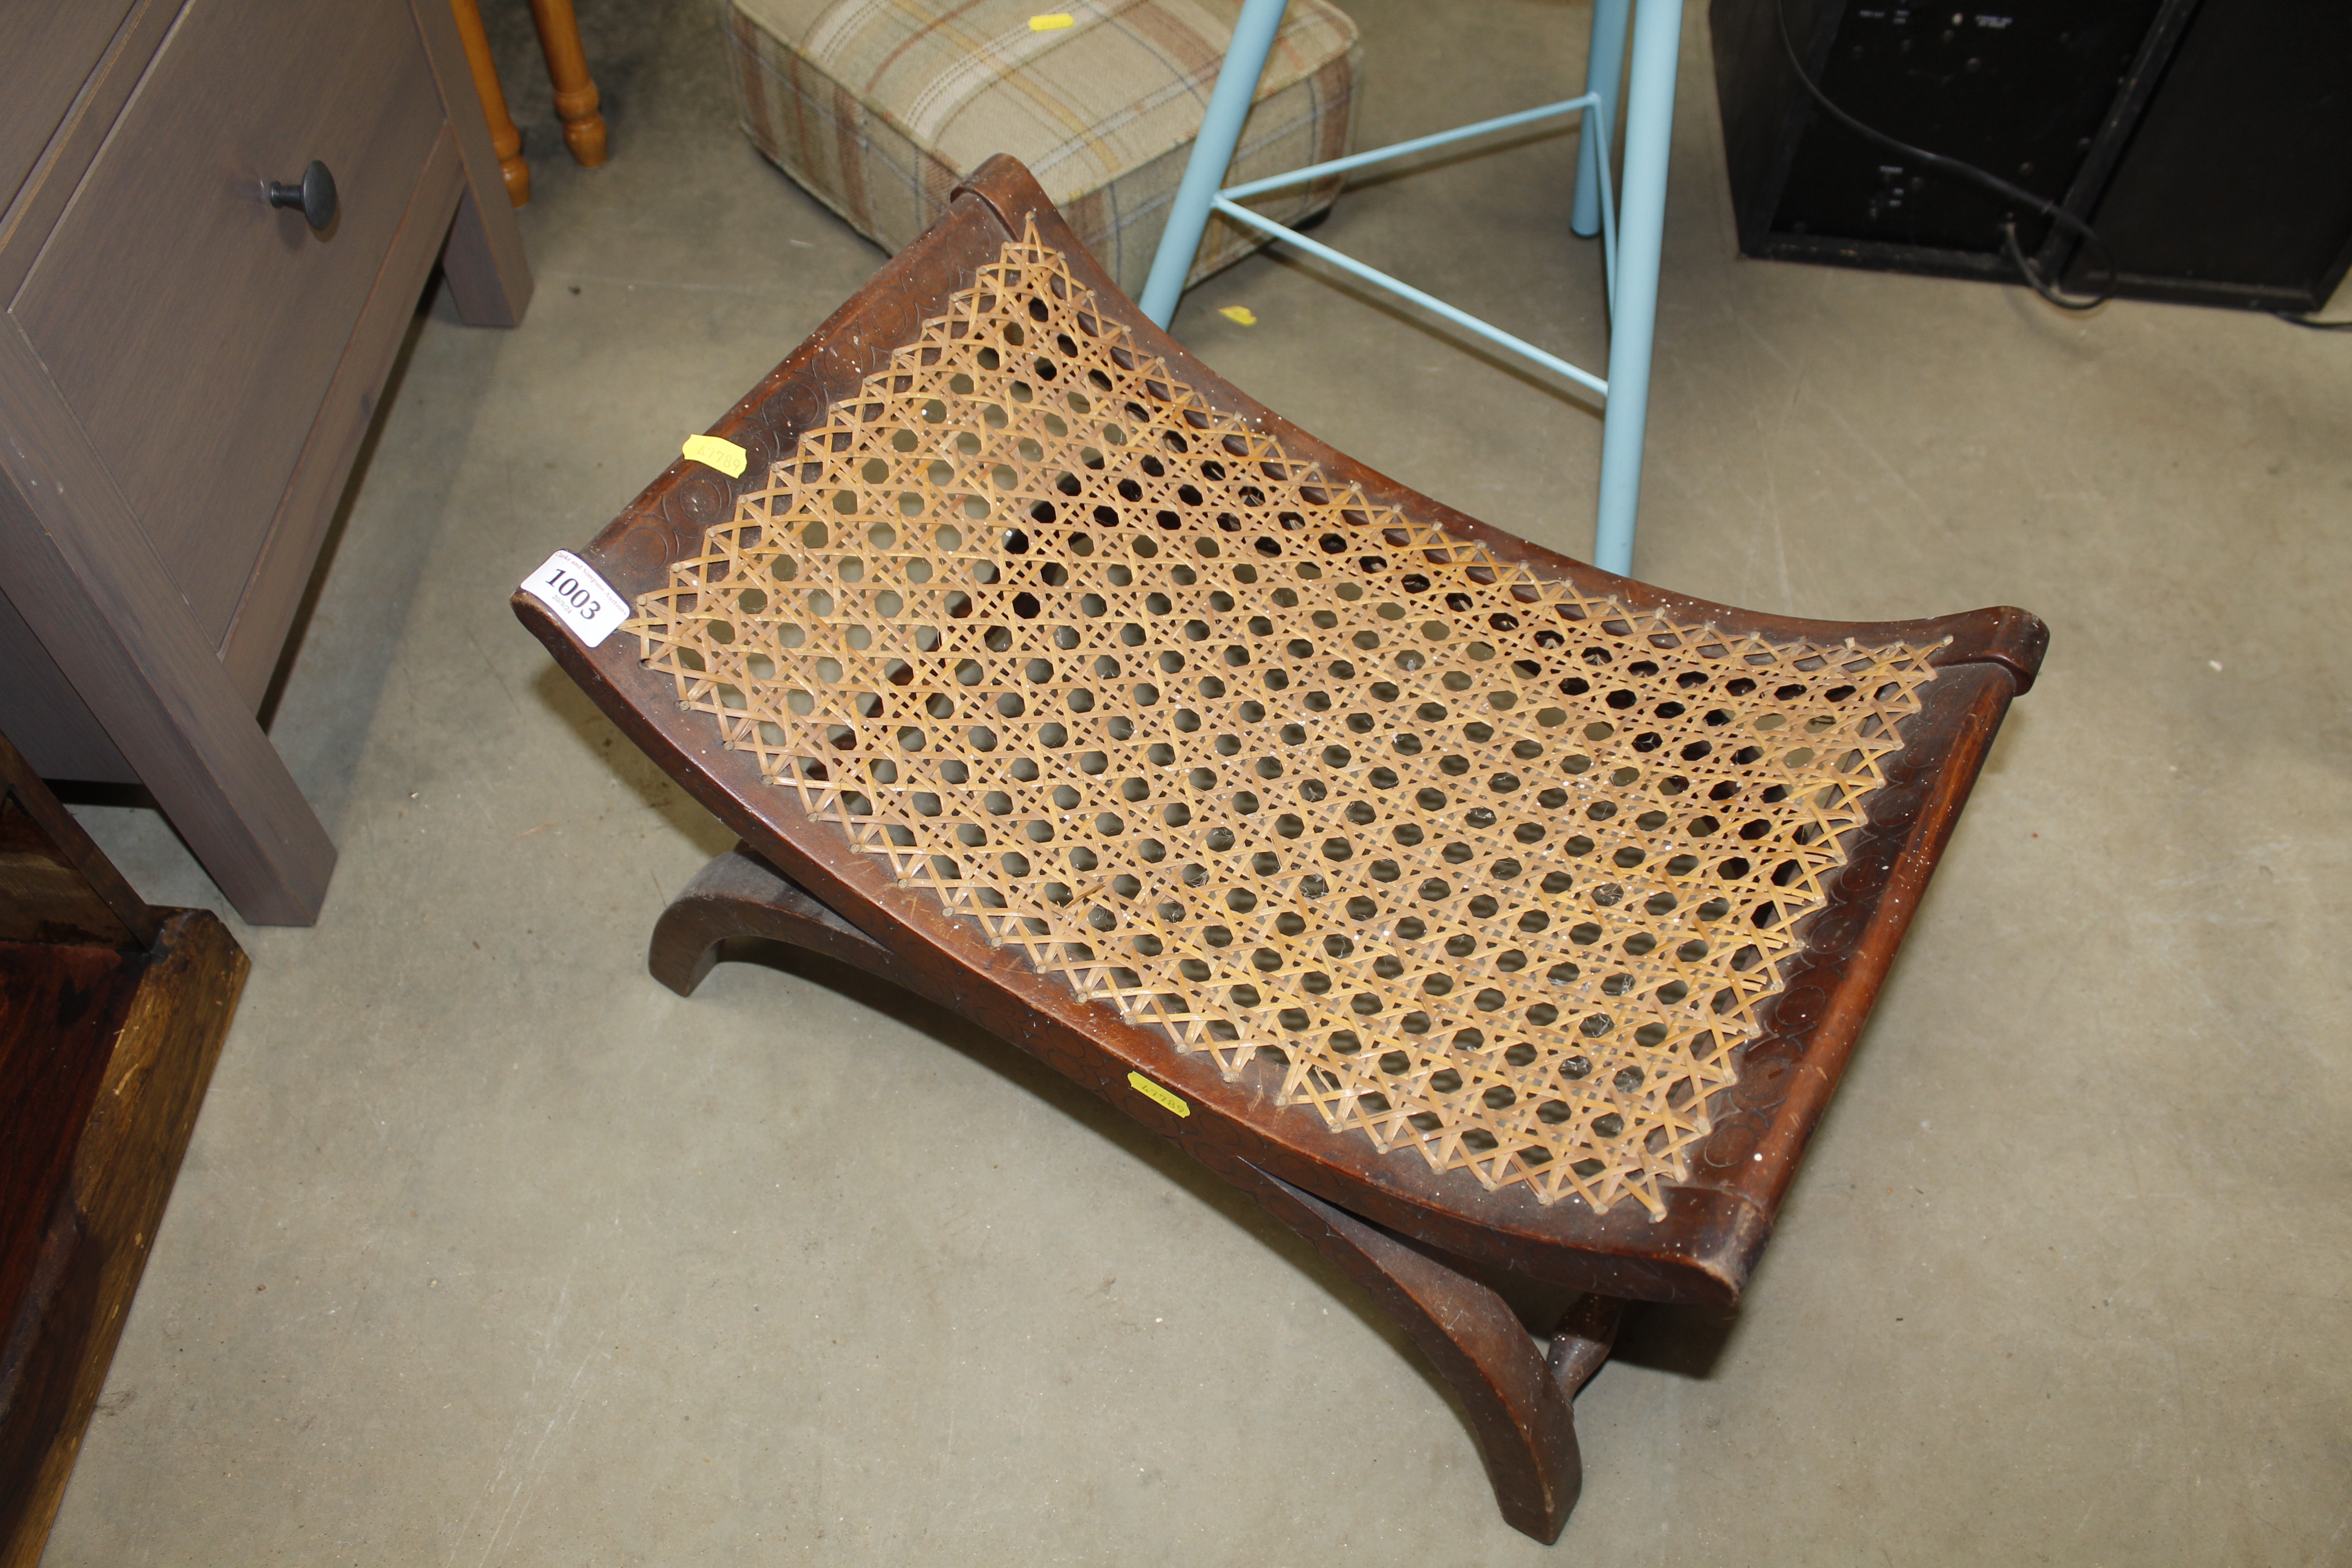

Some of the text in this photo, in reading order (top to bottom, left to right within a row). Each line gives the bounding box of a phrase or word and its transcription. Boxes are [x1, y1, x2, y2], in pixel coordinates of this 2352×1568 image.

[697, 446, 740, 471] 47789
[545, 568, 601, 620] 1003
[555, 551, 627, 616] Clarke and Simpson Auctions
[552, 594, 573, 614] 20/5/24
[1141, 1085, 1184, 1113] 47789
